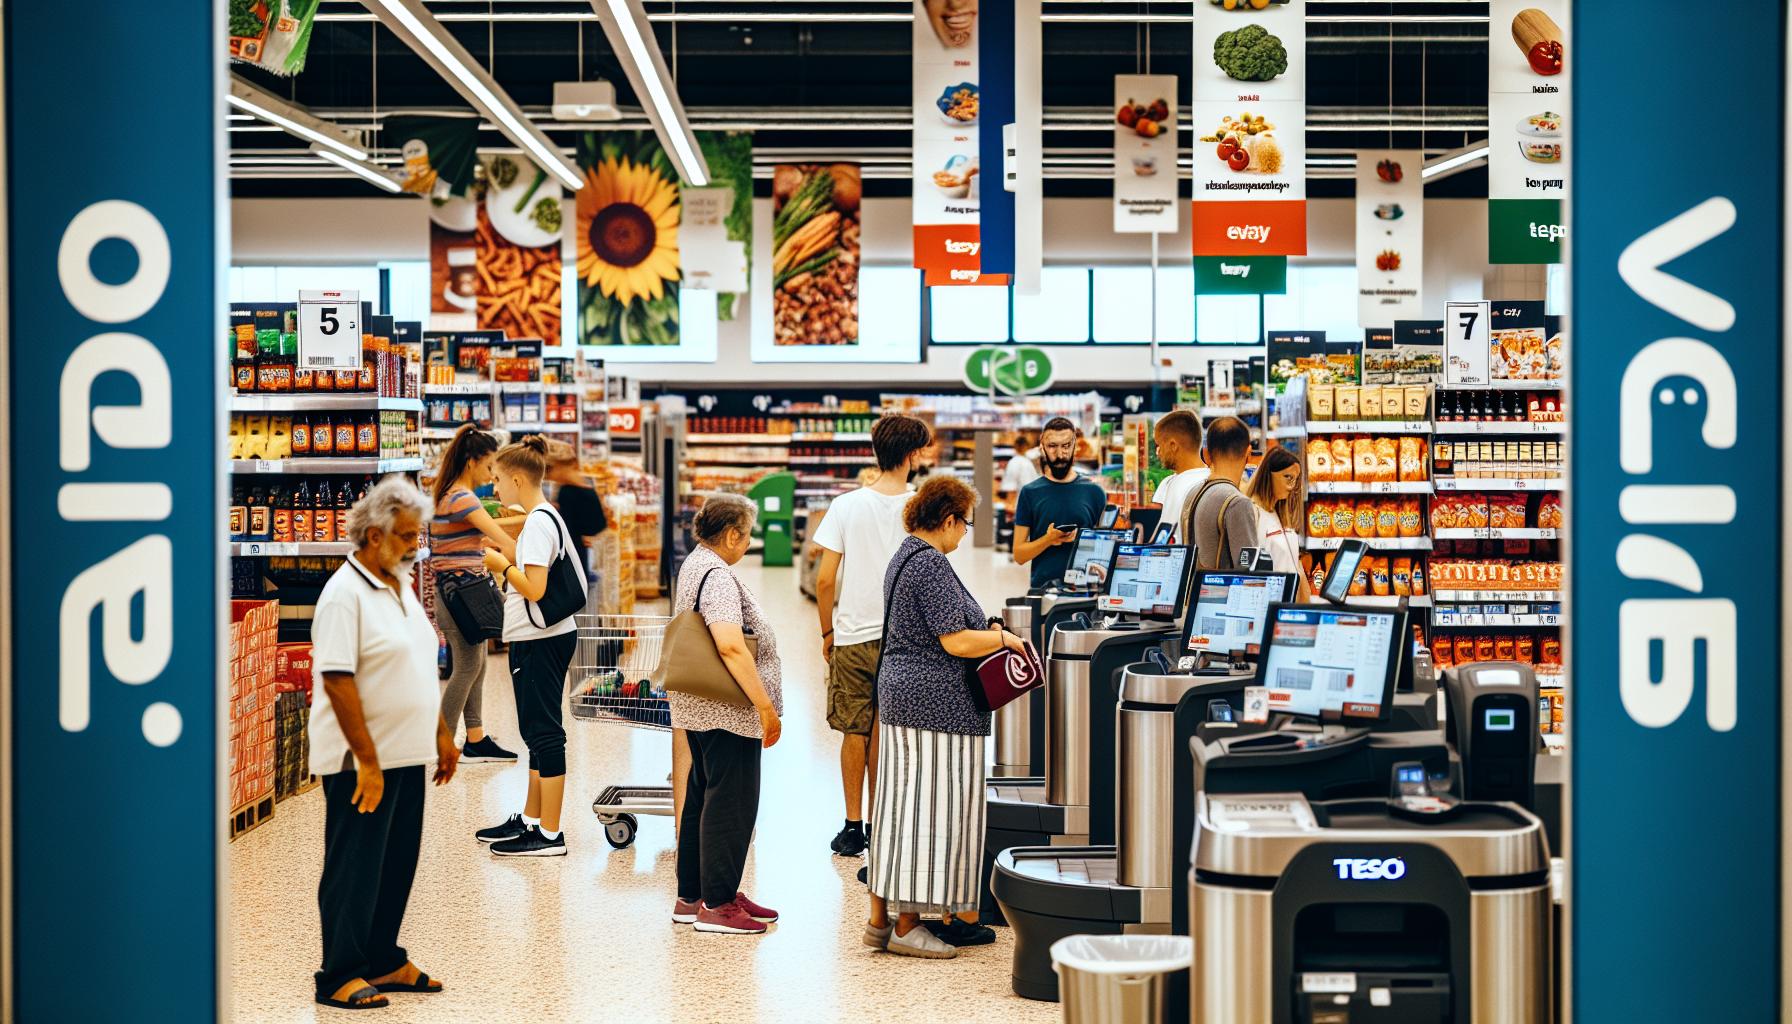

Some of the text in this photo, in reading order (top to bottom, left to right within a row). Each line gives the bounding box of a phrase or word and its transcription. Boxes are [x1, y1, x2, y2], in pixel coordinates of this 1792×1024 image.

[319, 307, 340, 336] 5
[1459, 312, 1479, 340] 7
[1333, 857, 1405, 880] TESO
